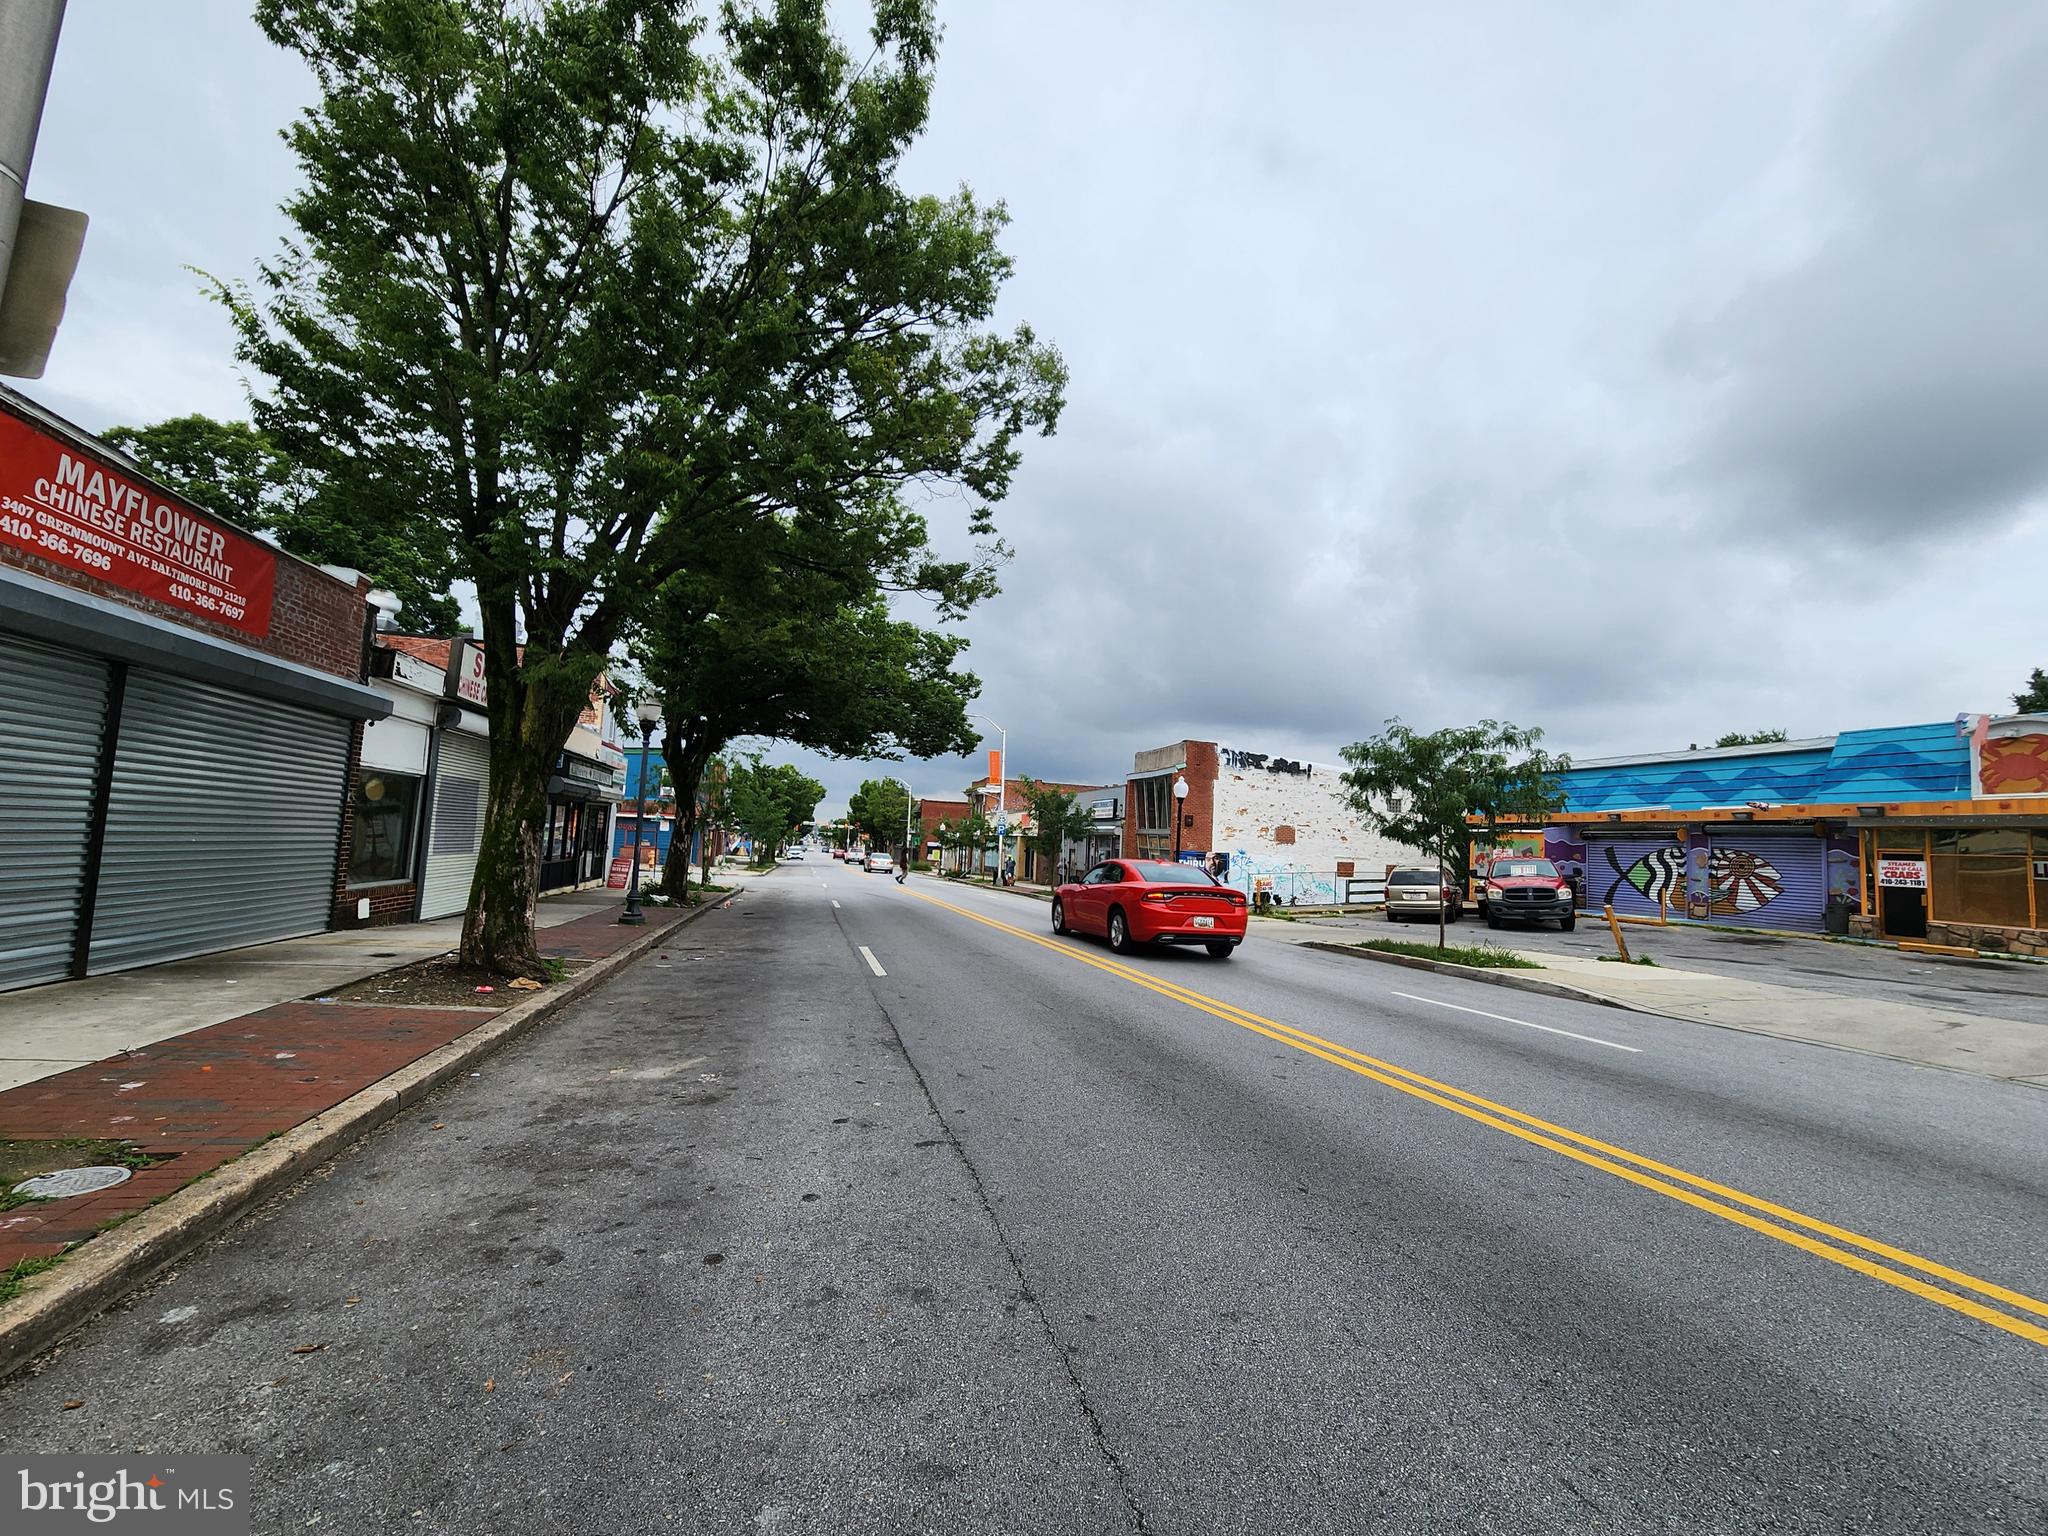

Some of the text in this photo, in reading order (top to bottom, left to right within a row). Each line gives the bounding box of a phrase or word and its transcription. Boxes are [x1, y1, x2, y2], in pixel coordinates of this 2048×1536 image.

[0, 514, 112, 571] 410-366-7696
[34, 477, 233, 582] CHINESE RESTAURANT
[55, 453, 225, 560] MAYFLOWER
[1, 496, 247, 606] 3407 GREENMOUNT AVE BALTIMORE MD 21218
[168, 583, 245, 621] 410-366-7697
[1884, 871, 1920, 879] CRABS
